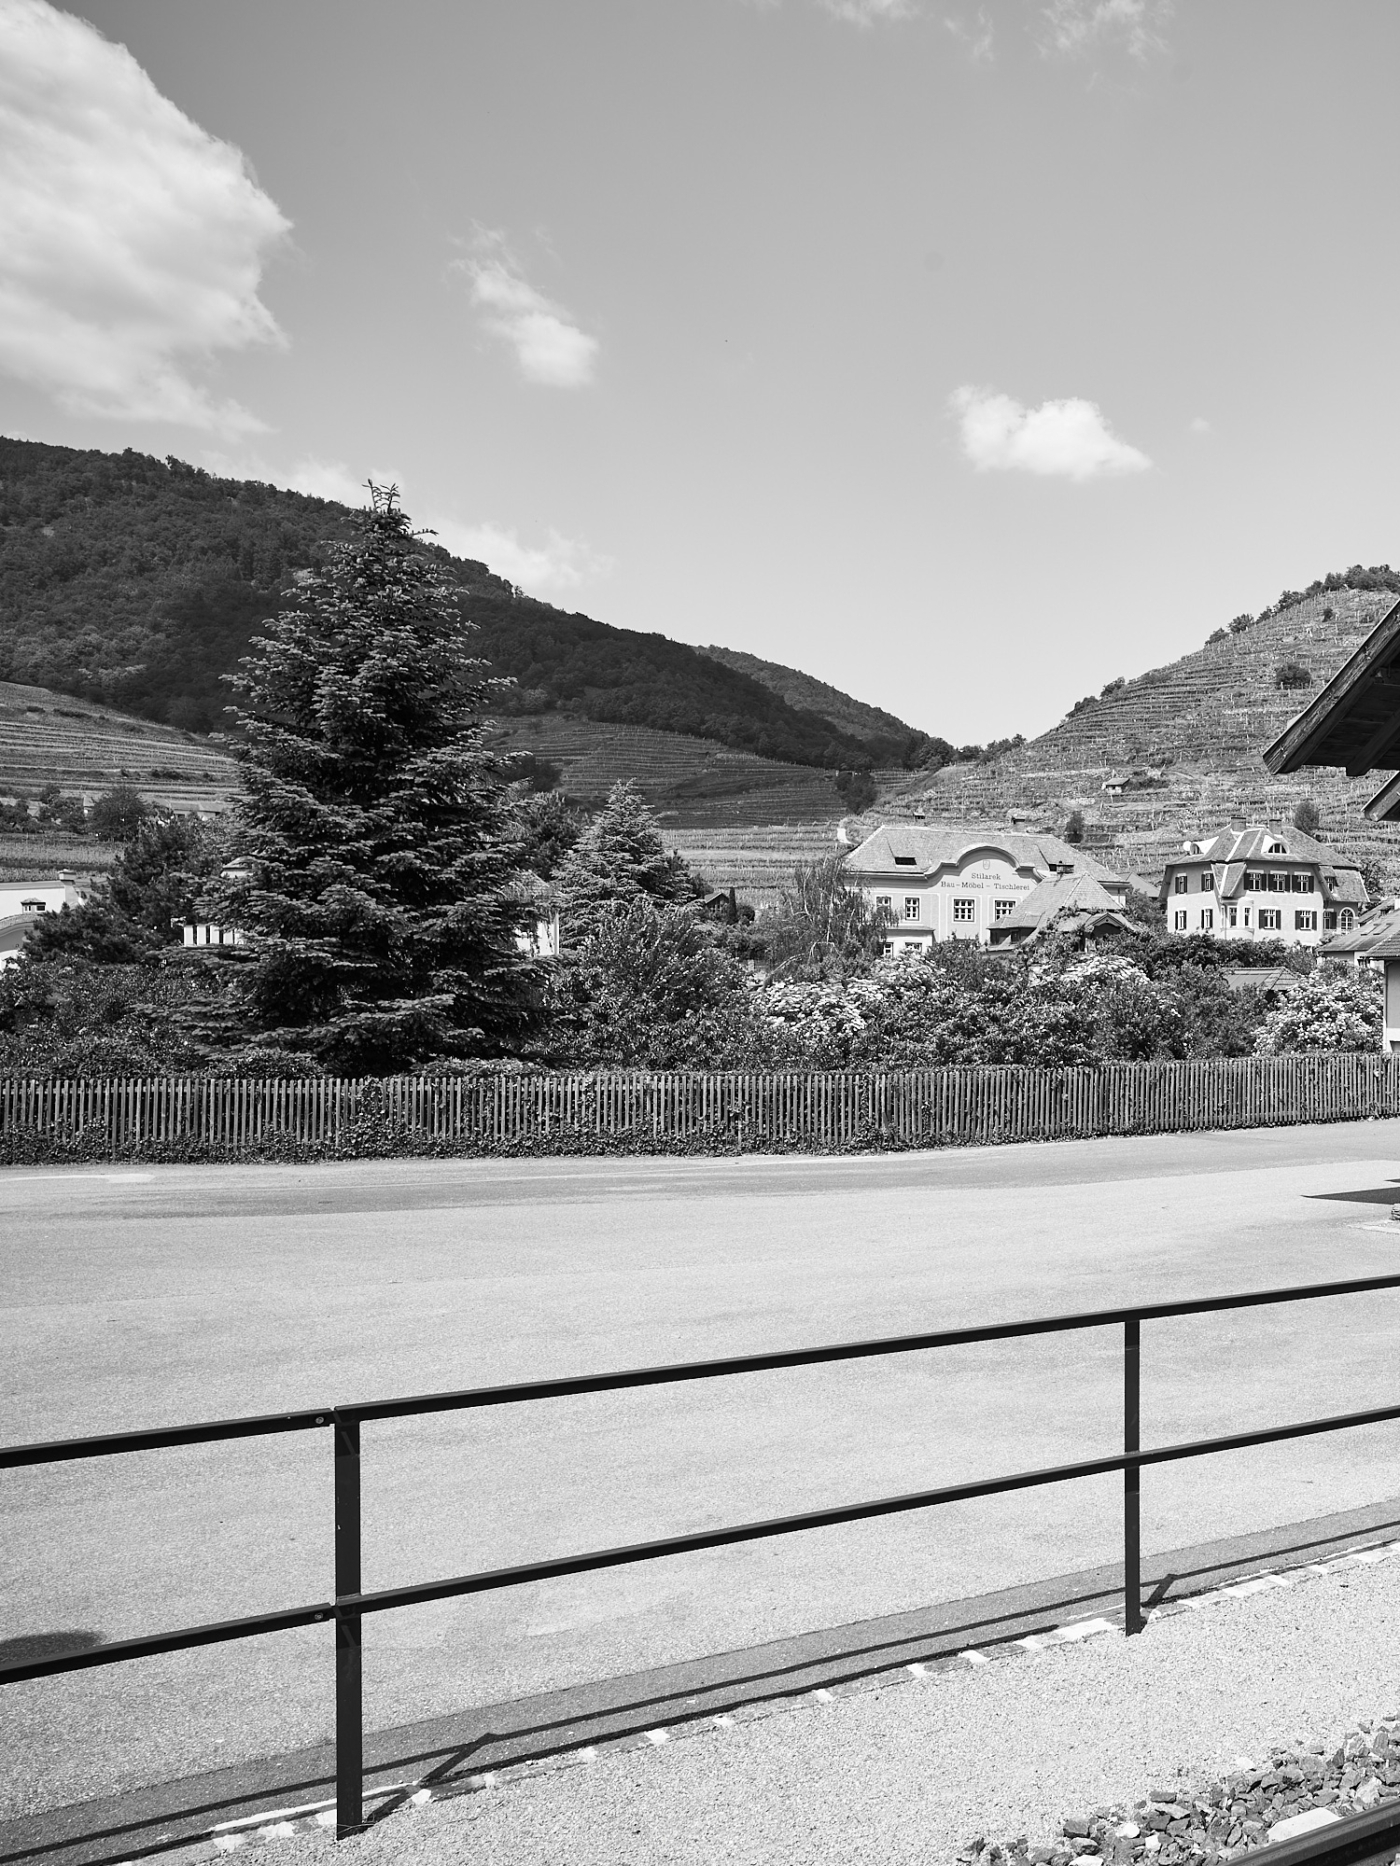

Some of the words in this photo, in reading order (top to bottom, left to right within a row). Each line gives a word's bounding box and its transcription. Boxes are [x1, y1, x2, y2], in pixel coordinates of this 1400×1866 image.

[971, 872, 1001, 880] Stilarek
[961, 881, 984, 889] Möbel
[993, 883, 1030, 891] Tischlerei
